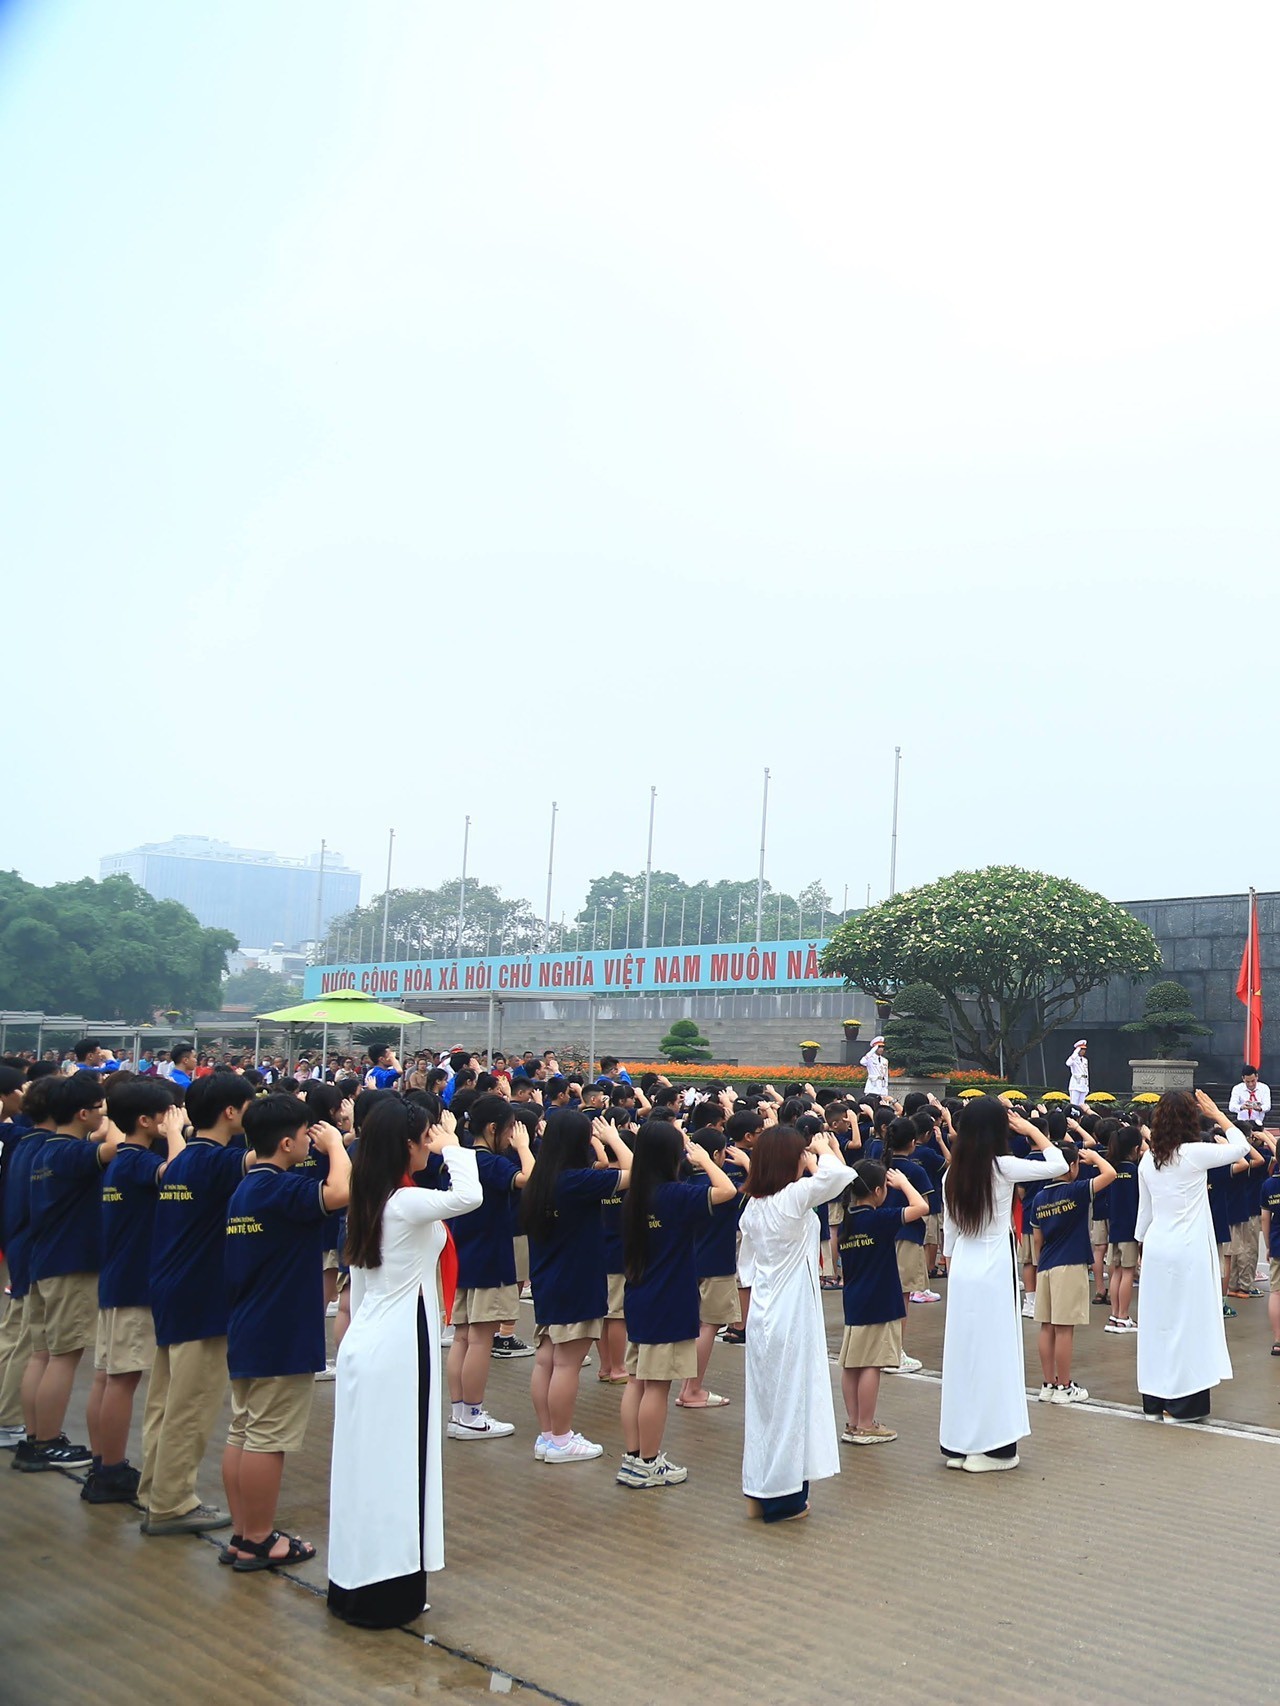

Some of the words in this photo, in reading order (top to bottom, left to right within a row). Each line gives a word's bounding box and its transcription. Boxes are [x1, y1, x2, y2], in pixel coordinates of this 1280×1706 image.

[361, 965, 399, 996] CỘNG
[404, 963, 432, 991] HÒA
[439, 962, 459, 990] XÃ
[499, 956, 532, 989] CHỦ
[539, 955, 594, 987] NGHĨA
[603, 952, 646, 990] VIỆT
[654, 954, 701, 984] NAM
[709, 946, 777, 982] MUÔN
[787, 943, 843, 980] NĂ
